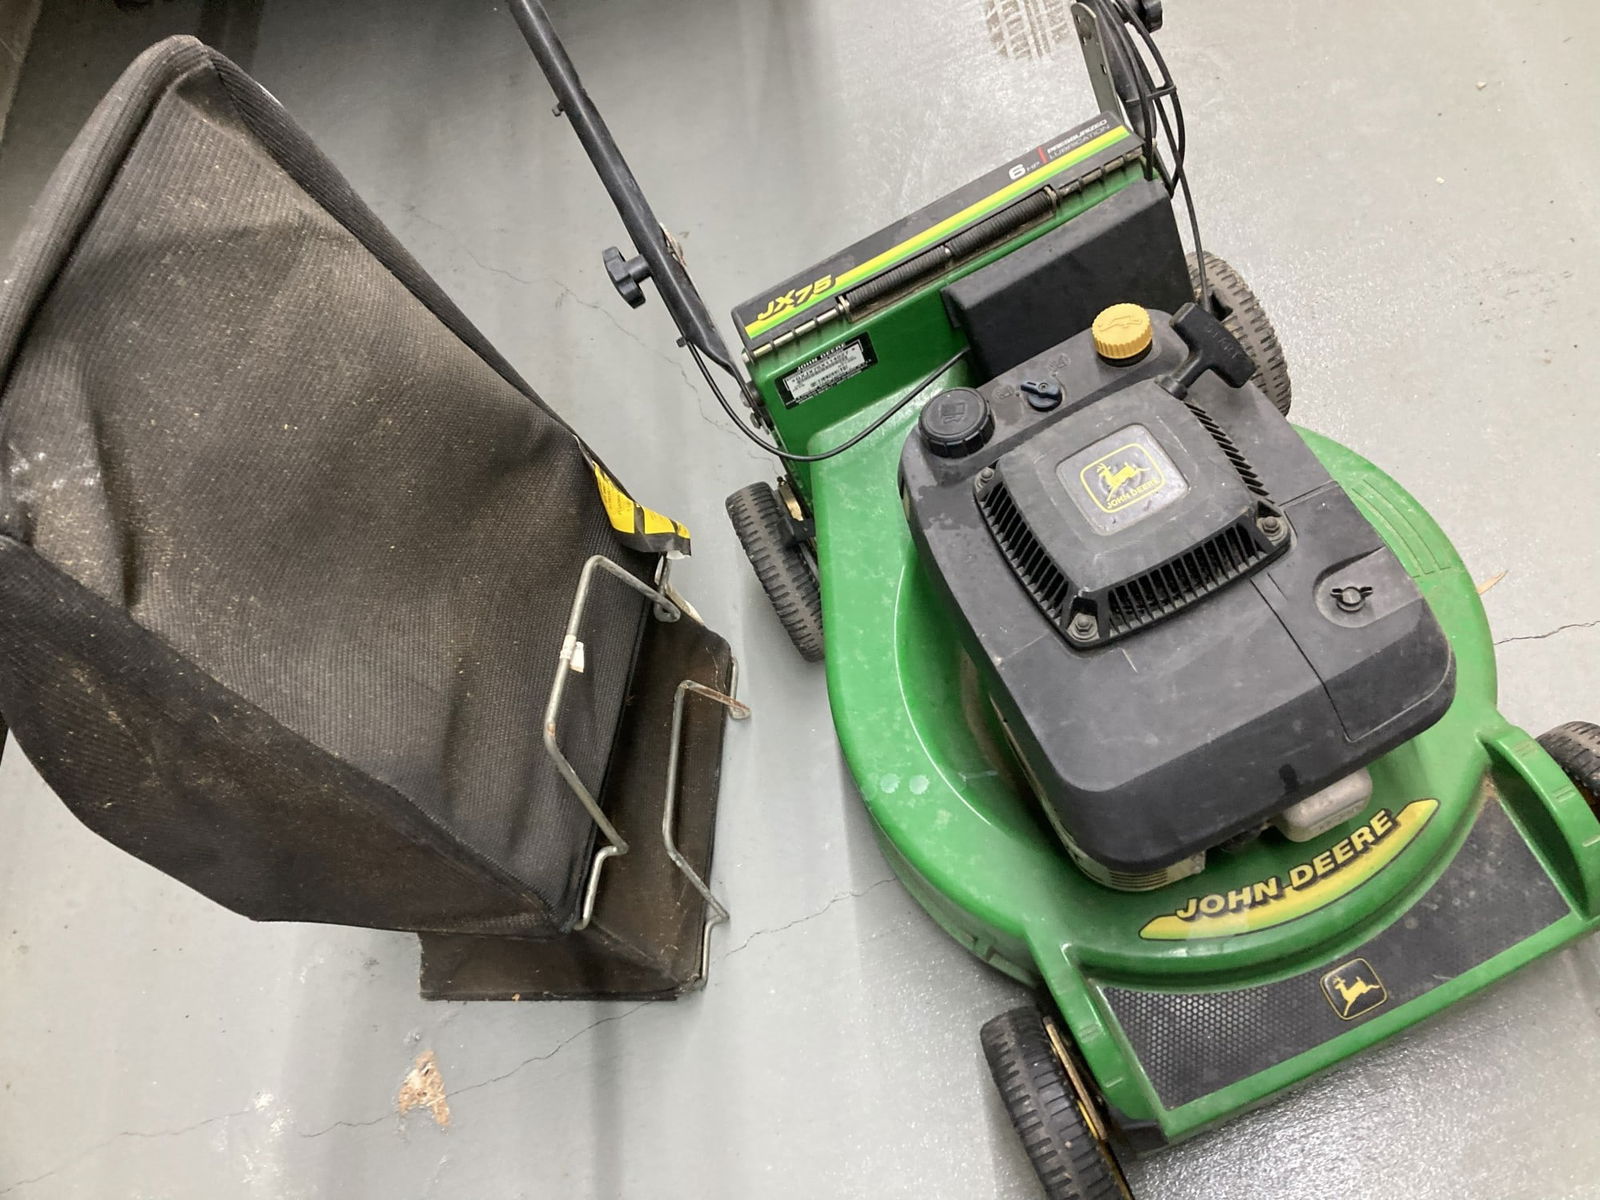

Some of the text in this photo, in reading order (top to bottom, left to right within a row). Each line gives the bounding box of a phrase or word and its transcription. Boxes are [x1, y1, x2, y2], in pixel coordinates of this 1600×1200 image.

[1049, 124, 1111, 160] LUBRICATION
[1008, 163, 1026, 180] 6
[757, 274, 832, 320] JX75
[1107, 492, 1132, 509] JOHN
[1176, 809, 1395, 920] JOHN DEERE
